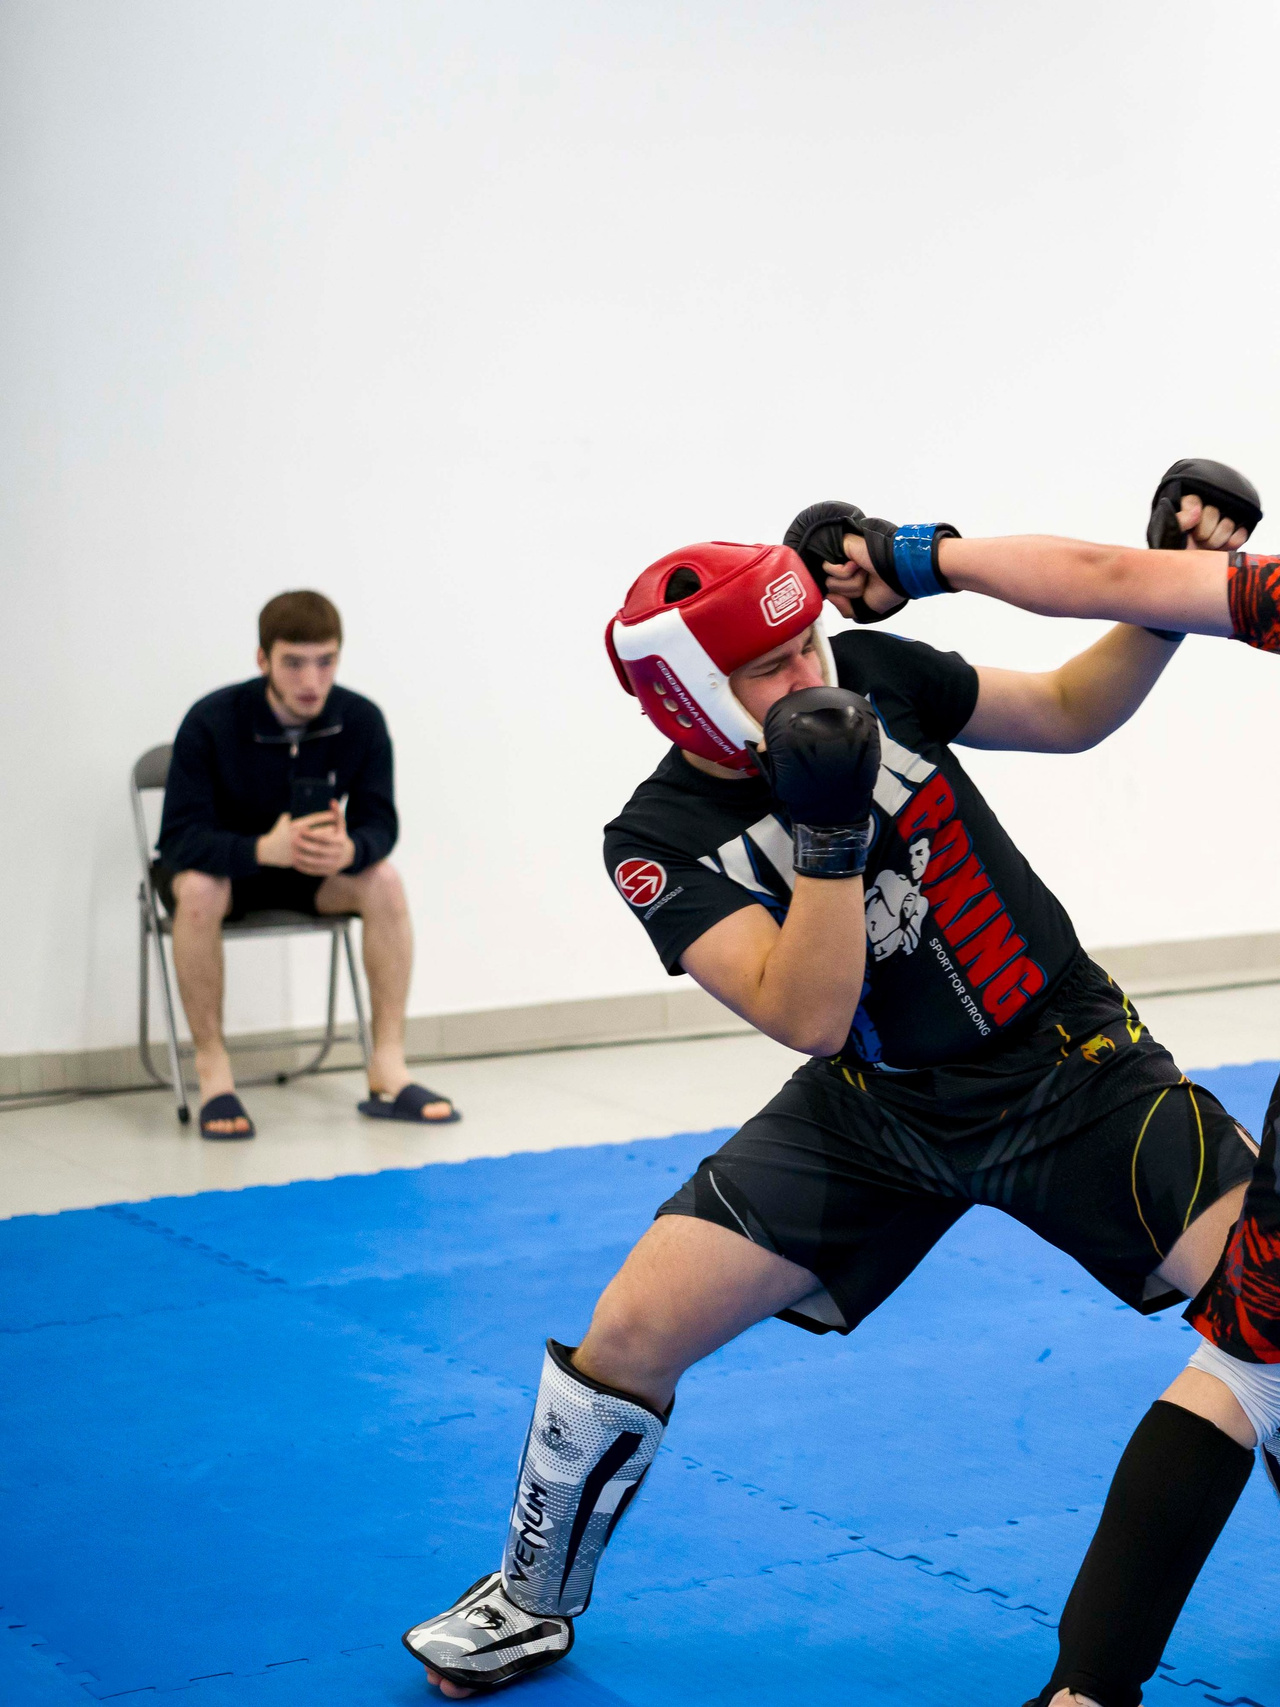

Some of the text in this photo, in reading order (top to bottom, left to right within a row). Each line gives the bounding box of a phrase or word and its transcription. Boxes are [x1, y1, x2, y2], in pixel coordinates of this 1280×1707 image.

[897, 772, 1047, 1027] BOXING
[929, 938, 991, 1036] SPORT FOR STRONG
[509, 1482, 548, 1581] VENUM
